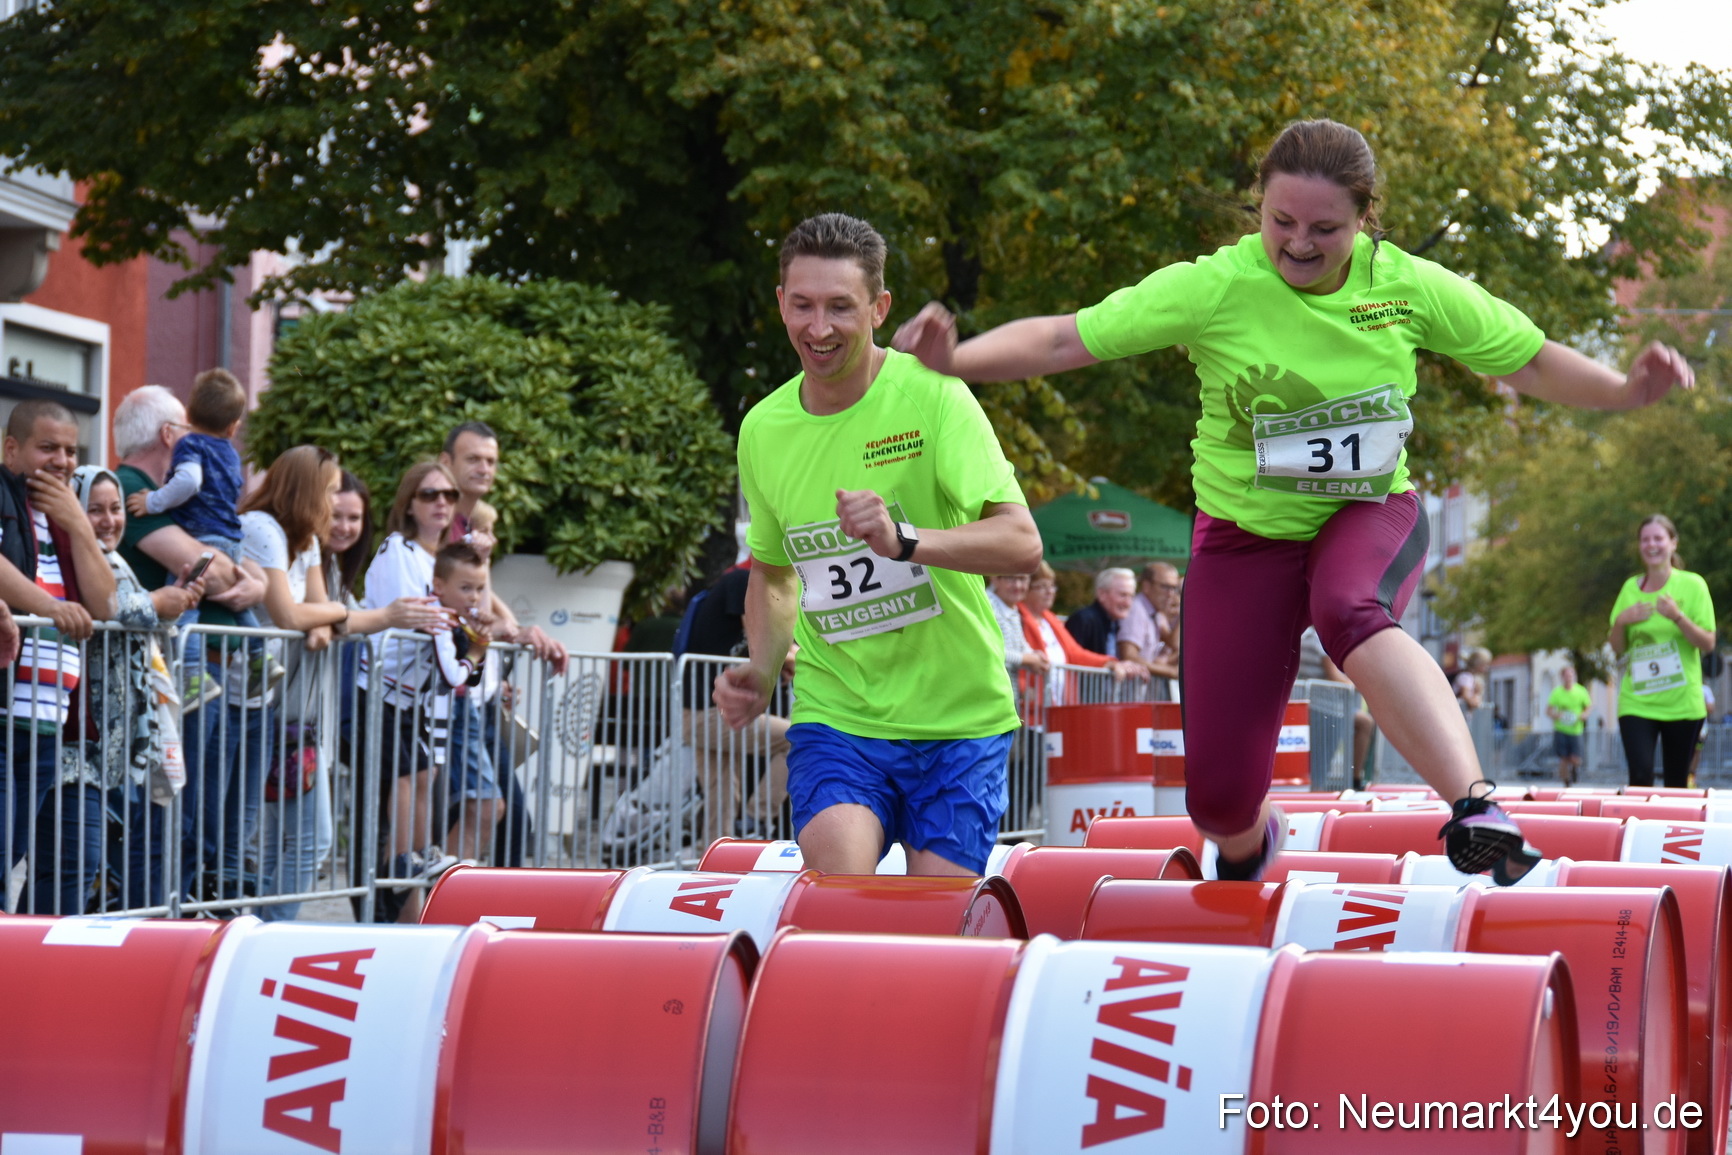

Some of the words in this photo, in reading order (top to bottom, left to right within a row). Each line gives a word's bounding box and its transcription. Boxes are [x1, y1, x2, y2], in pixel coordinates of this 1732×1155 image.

[1367, 320, 1397, 331] September
[1265, 390, 1398, 434] BOCK
[1307, 433, 1360, 473] 31
[1297, 481, 1373, 494] ELENA
[793, 525, 870, 559] BOC
[828, 556, 882, 599] 32
[816, 593, 917, 631] YEVGENIY
[1649, 661, 1660, 677] 9
[1661, 825, 1704, 864] AV
[669, 877, 741, 922] AV
[1613, 909, 1632, 959] 12414-B&B
